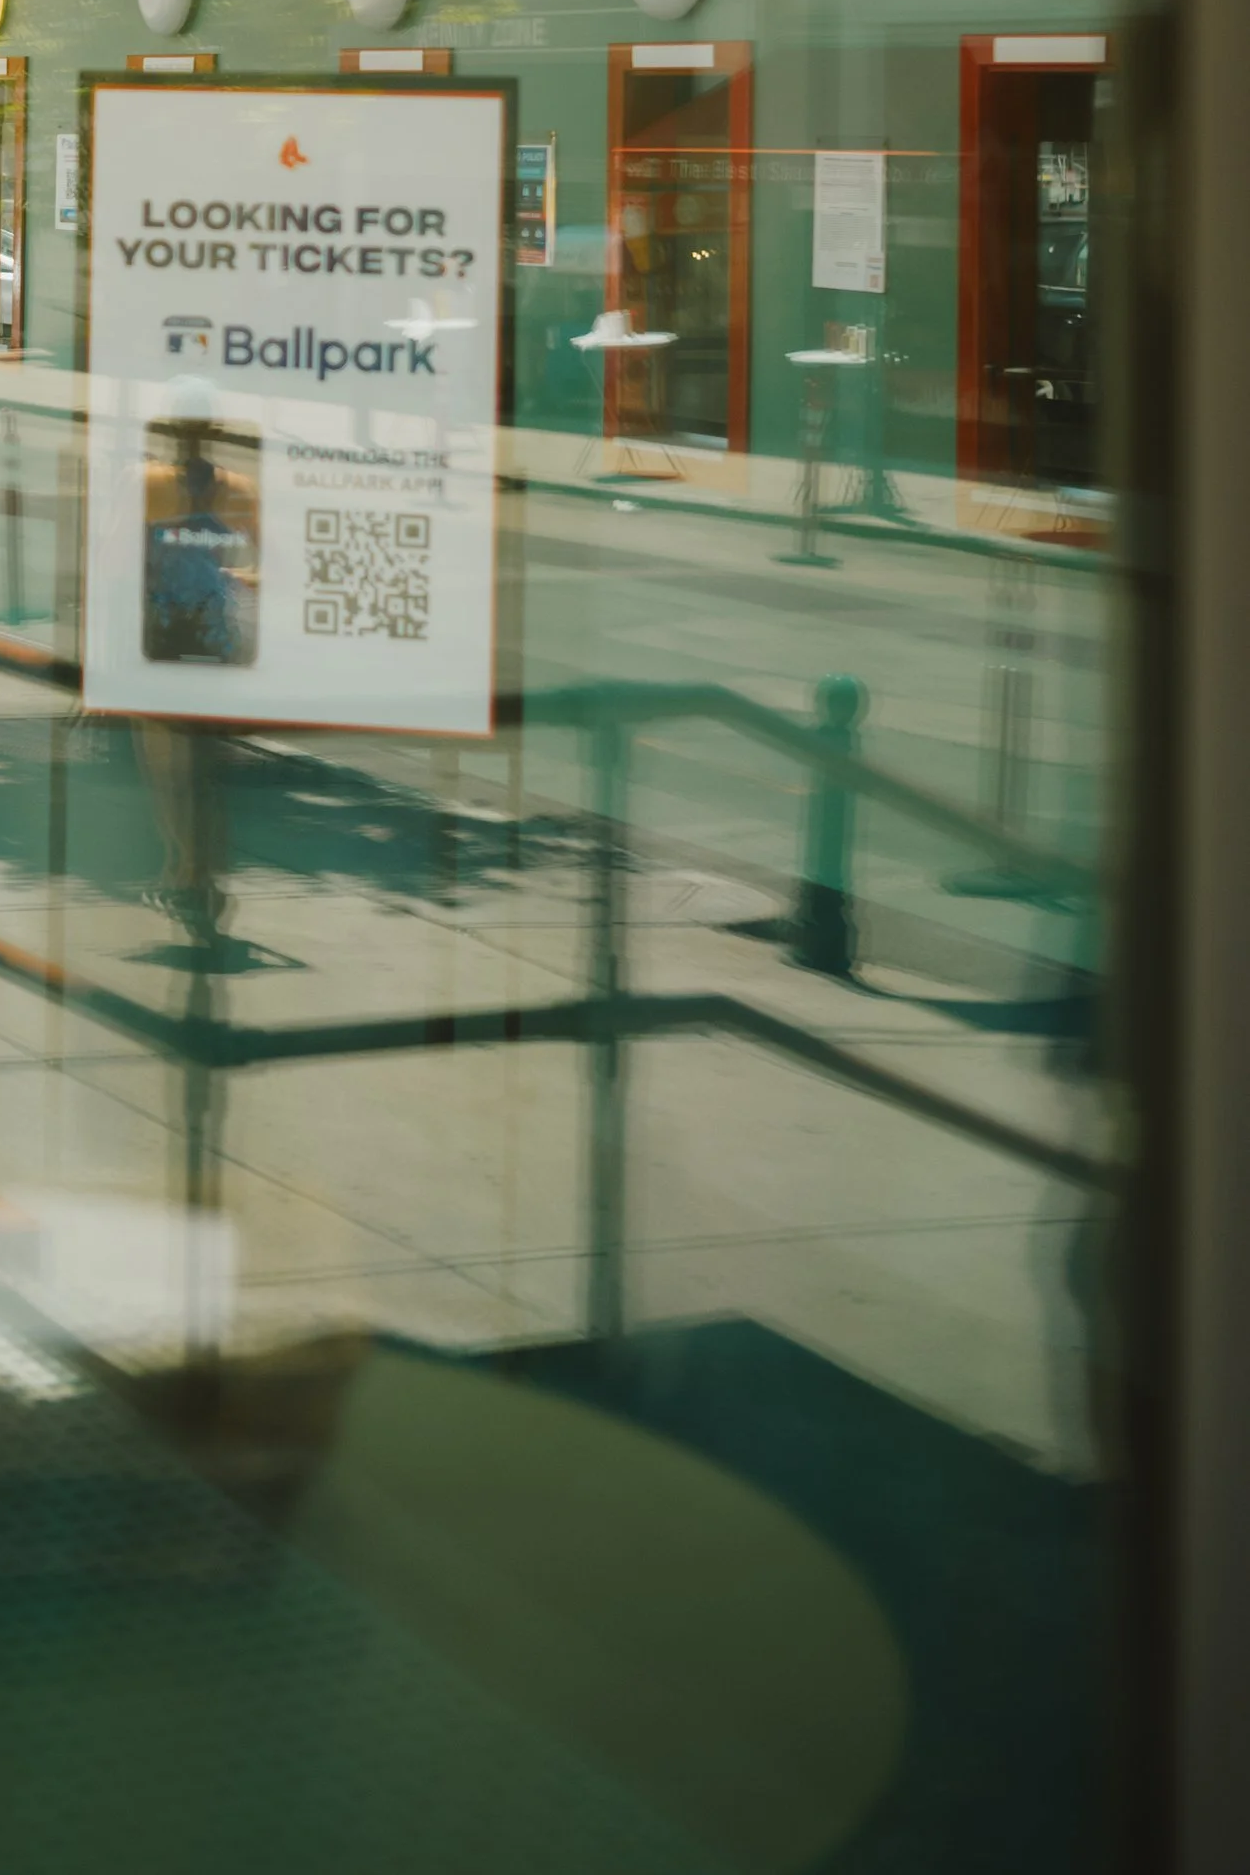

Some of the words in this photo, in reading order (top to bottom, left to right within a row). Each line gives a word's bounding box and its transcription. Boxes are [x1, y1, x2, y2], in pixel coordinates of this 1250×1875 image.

[141, 198, 342, 234] LOOKING
[354, 206, 446, 237] FOR
[116, 237, 237, 270] YOUR
[250, 241, 475, 279] TICKETS?
[222, 324, 438, 382] Ballpark
[286, 442, 407, 467] DOWNLOAD
[292, 471, 393, 491] BALLPARK
